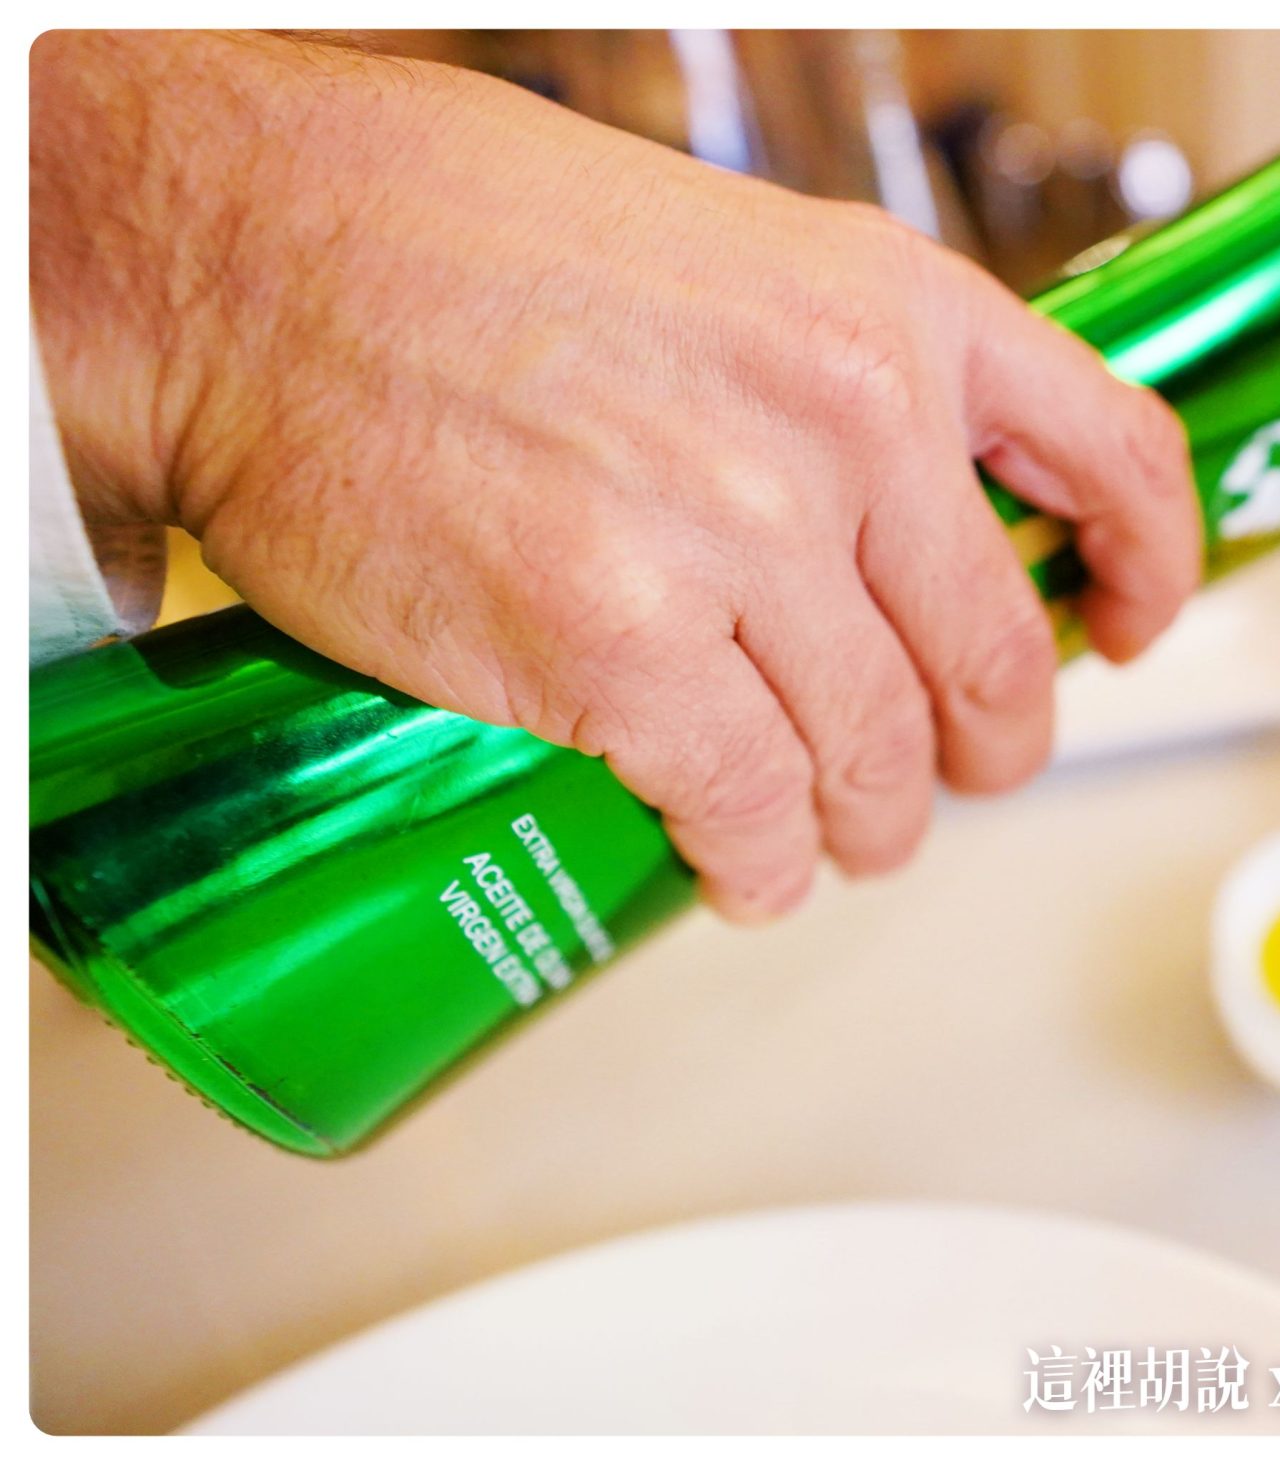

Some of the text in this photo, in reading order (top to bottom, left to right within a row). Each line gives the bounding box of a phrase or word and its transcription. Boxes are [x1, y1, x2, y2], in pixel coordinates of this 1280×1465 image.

[511, 813, 560, 877] EXTRA
[439, 880, 508, 964] VIRGEN
[462, 852, 552, 958] ACEITE DE
